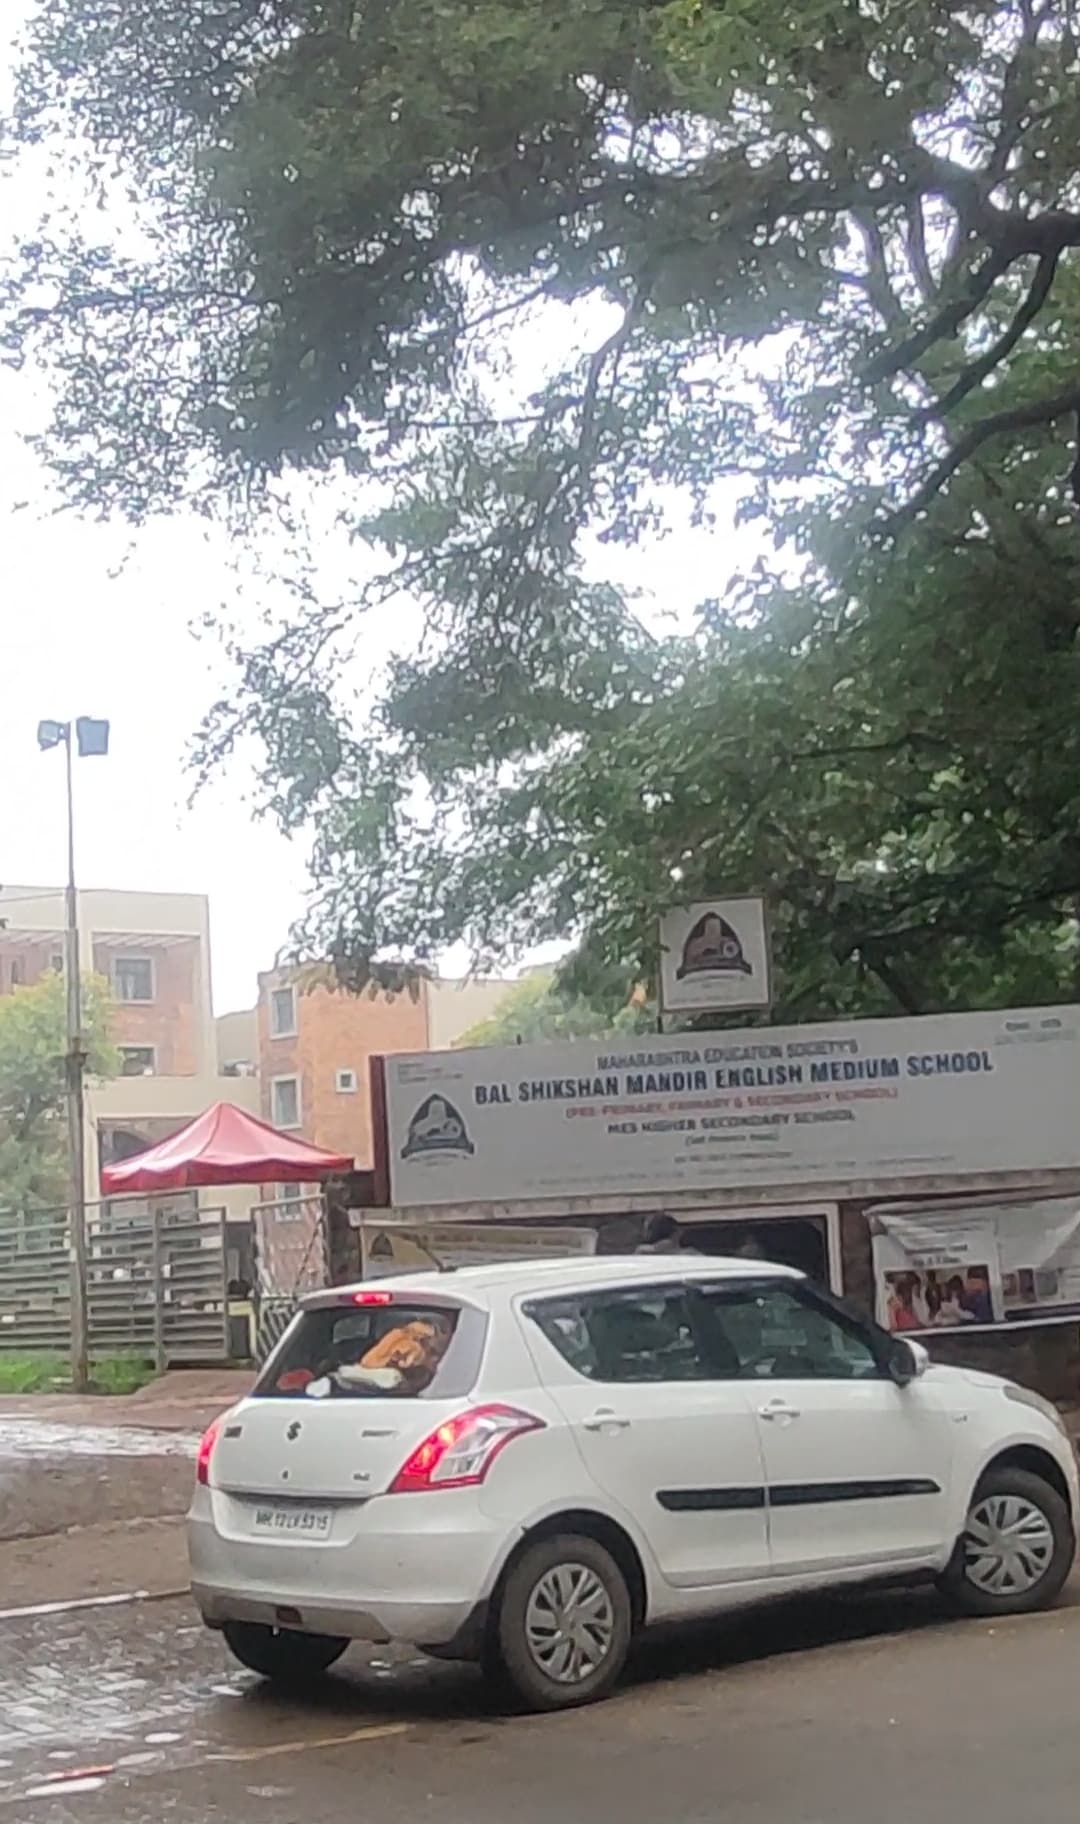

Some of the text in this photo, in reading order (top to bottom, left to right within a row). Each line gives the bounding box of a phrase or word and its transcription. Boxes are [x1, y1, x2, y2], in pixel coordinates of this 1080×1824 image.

[704, 1045, 783, 1063] EDUCATION
[474, 1051, 994, 1105] BAL SHIKSHAN MANDIR ENGLISH MEDIUM SCHOOL
